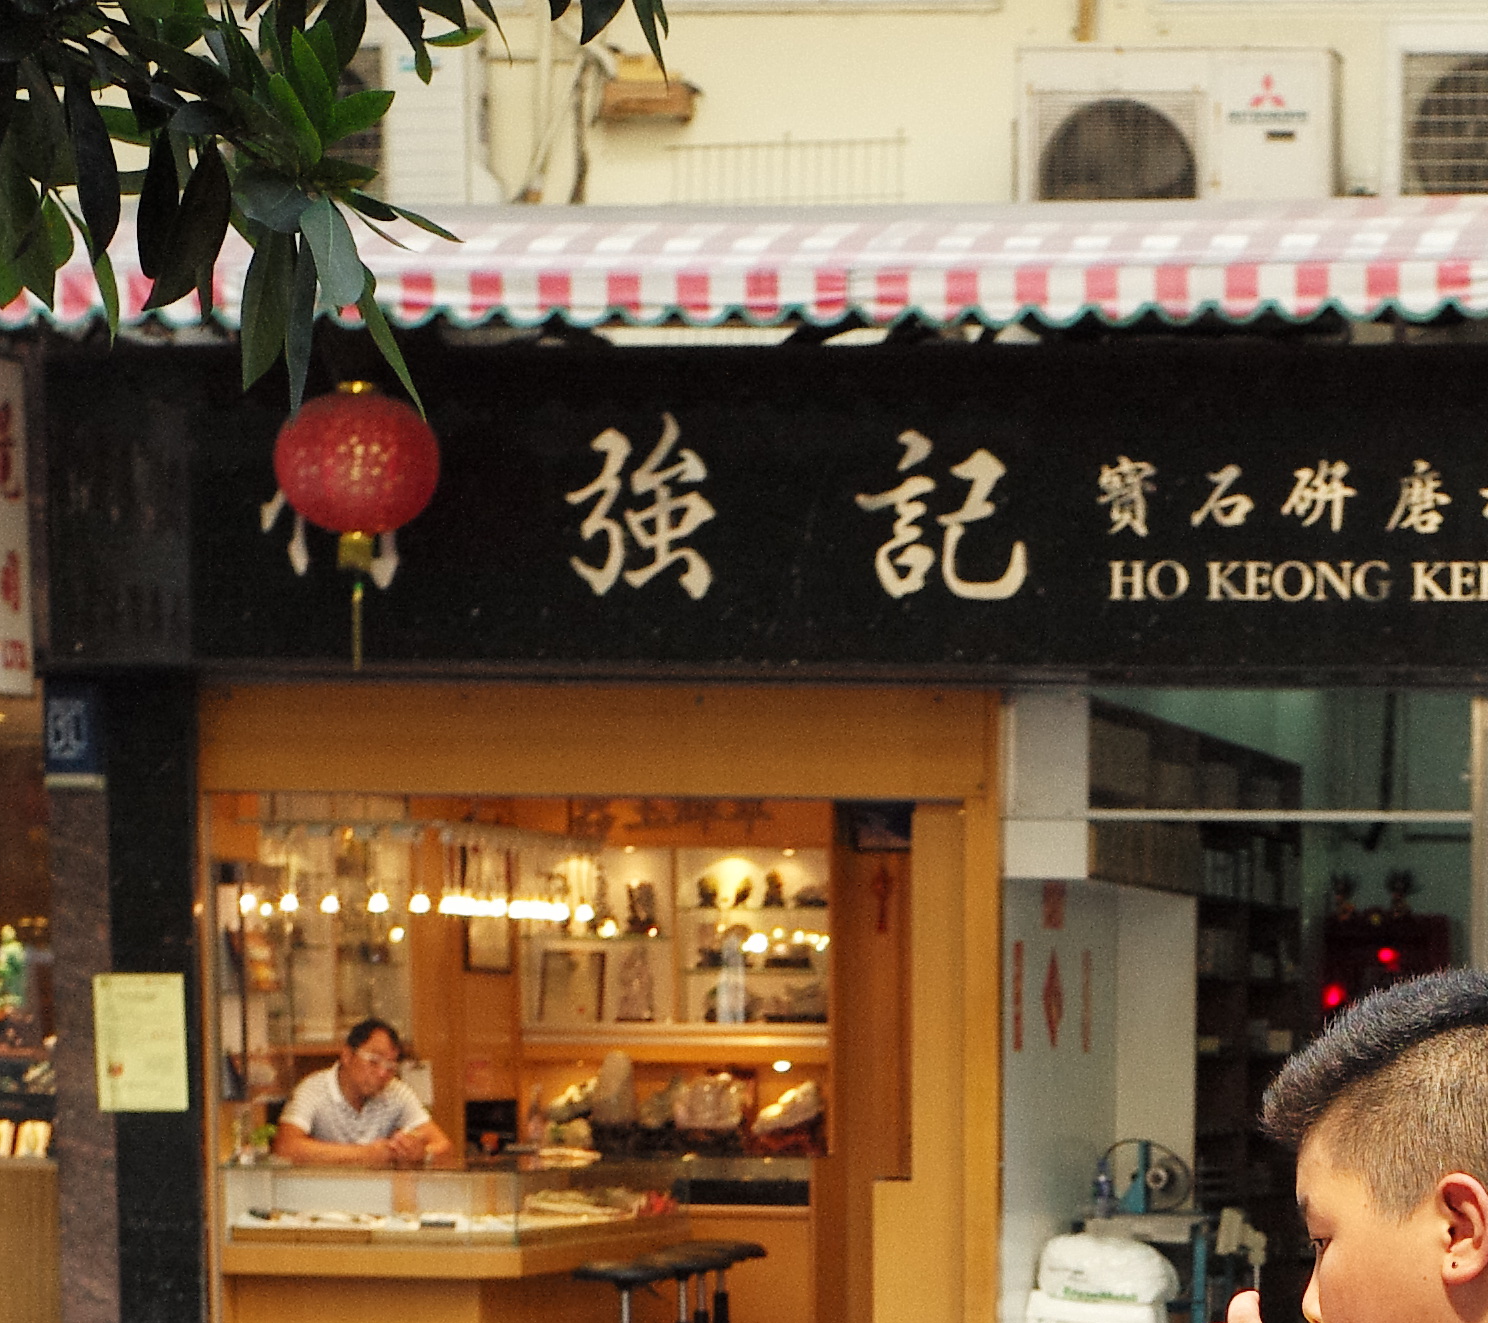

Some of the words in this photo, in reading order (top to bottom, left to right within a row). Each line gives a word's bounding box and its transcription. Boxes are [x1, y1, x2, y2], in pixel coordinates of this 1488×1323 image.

[261, 412, 1028, 602] 強記
[1109, 560, 1190, 602] HO
[1206, 560, 1391, 602] KEONG
